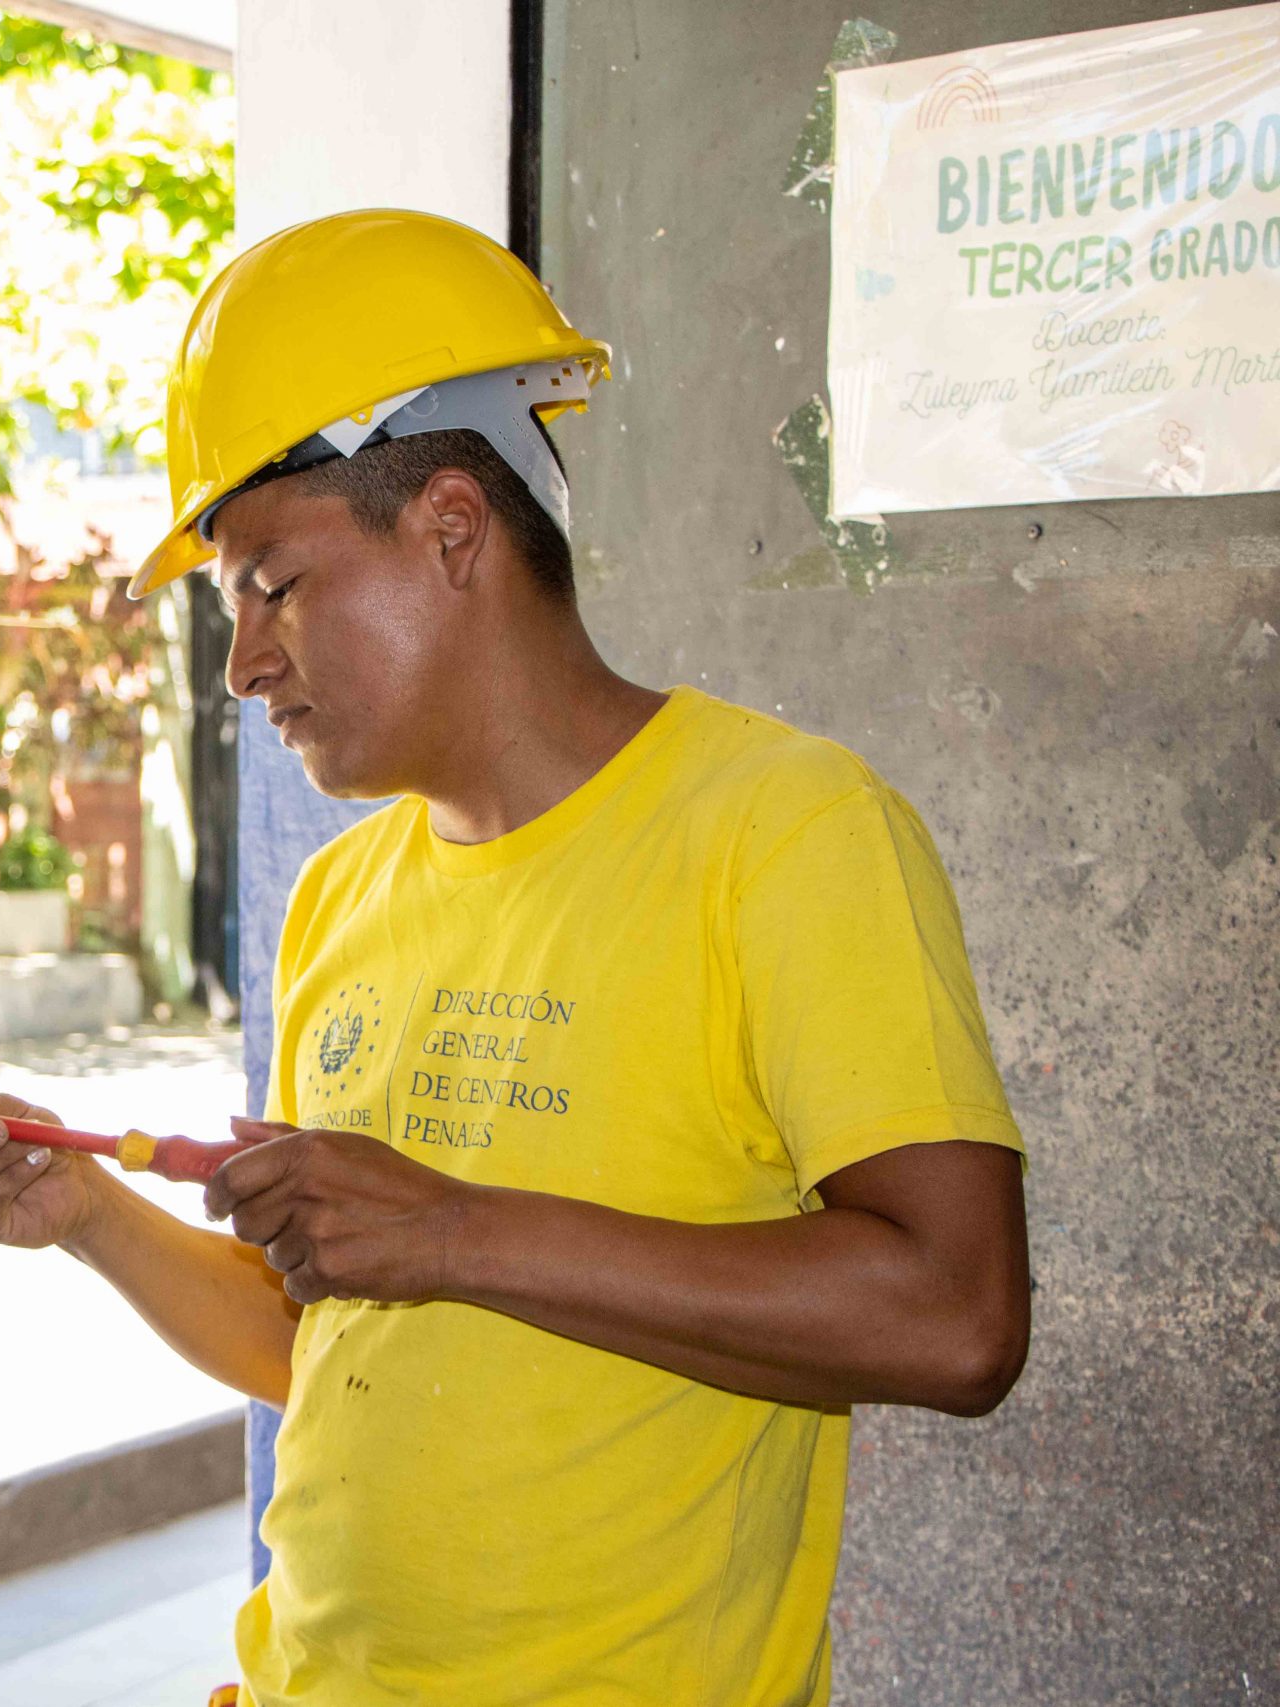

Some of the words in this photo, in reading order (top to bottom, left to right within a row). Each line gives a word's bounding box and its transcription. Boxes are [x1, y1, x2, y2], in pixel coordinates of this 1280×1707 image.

[958, 235, 1133, 298] TERCER
[1149, 216, 1280, 282] GRADO
[1032, 309, 1167, 353] Docente:
[431, 989, 576, 1025] DIRECCIÓN
[422, 1030, 529, 1063] GENERAL
[409, 1071, 451, 1102] DE
[457, 1078, 571, 1115] CENTROS
[349, 1109, 373, 1126] DE
[402, 1113, 495, 1148] PENALES
